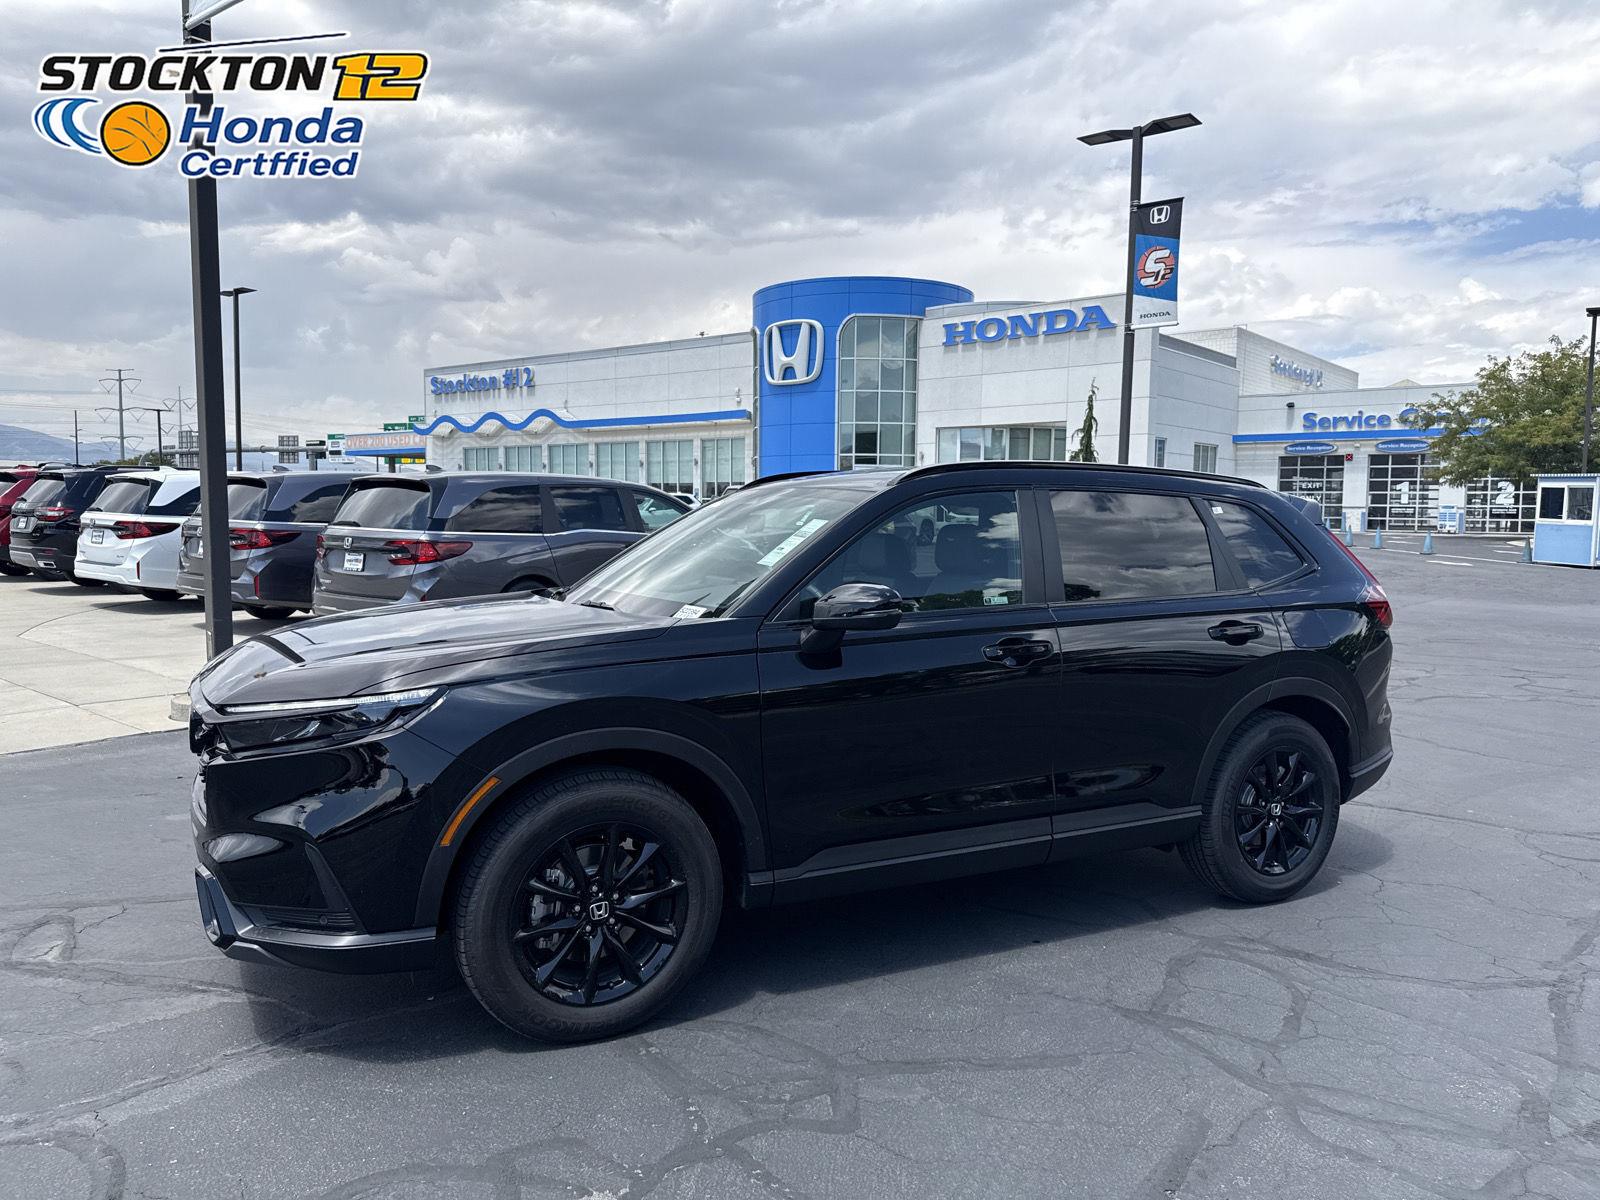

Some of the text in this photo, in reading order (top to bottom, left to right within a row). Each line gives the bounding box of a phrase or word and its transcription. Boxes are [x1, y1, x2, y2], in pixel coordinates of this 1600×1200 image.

[942, 304, 1117, 347] HONDA
[1139, 310, 1171, 320] HONDA
[430, 366, 535, 395] Stockton #12
[1302, 409, 1391, 432] Service
[346, 435, 368, 448] OVER
[369, 435, 384, 447] 200
[387, 433, 409, 446] USED
[1395, 481, 1410, 504] 1
[1495, 480, 1516, 505] 2
